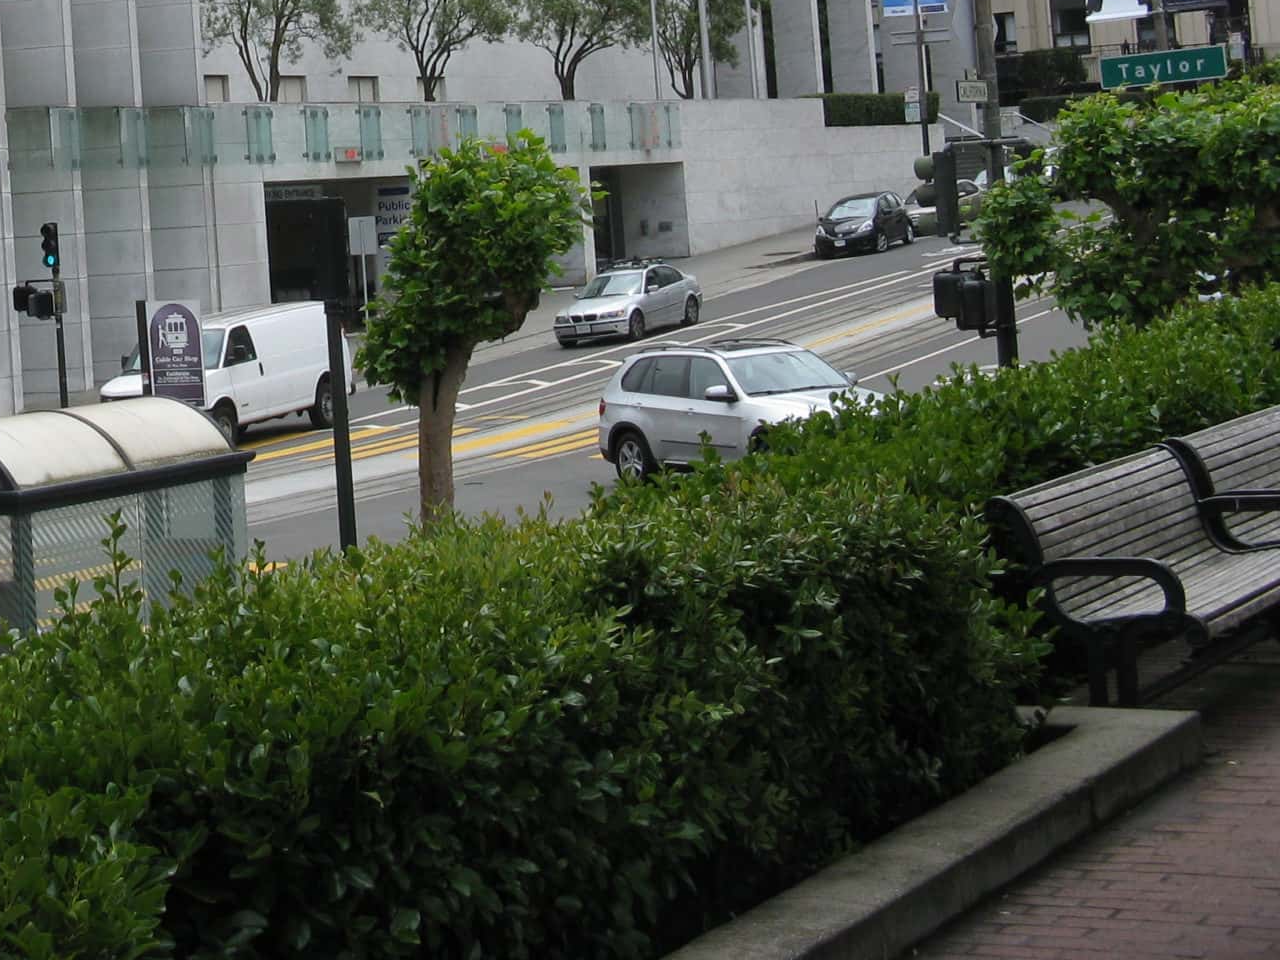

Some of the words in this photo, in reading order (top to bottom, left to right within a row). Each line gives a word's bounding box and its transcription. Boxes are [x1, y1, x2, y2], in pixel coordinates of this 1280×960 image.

[1117, 58, 1205, 80] Taylor
[378, 200, 410, 212] Public
[376, 215, 403, 226] Parki
